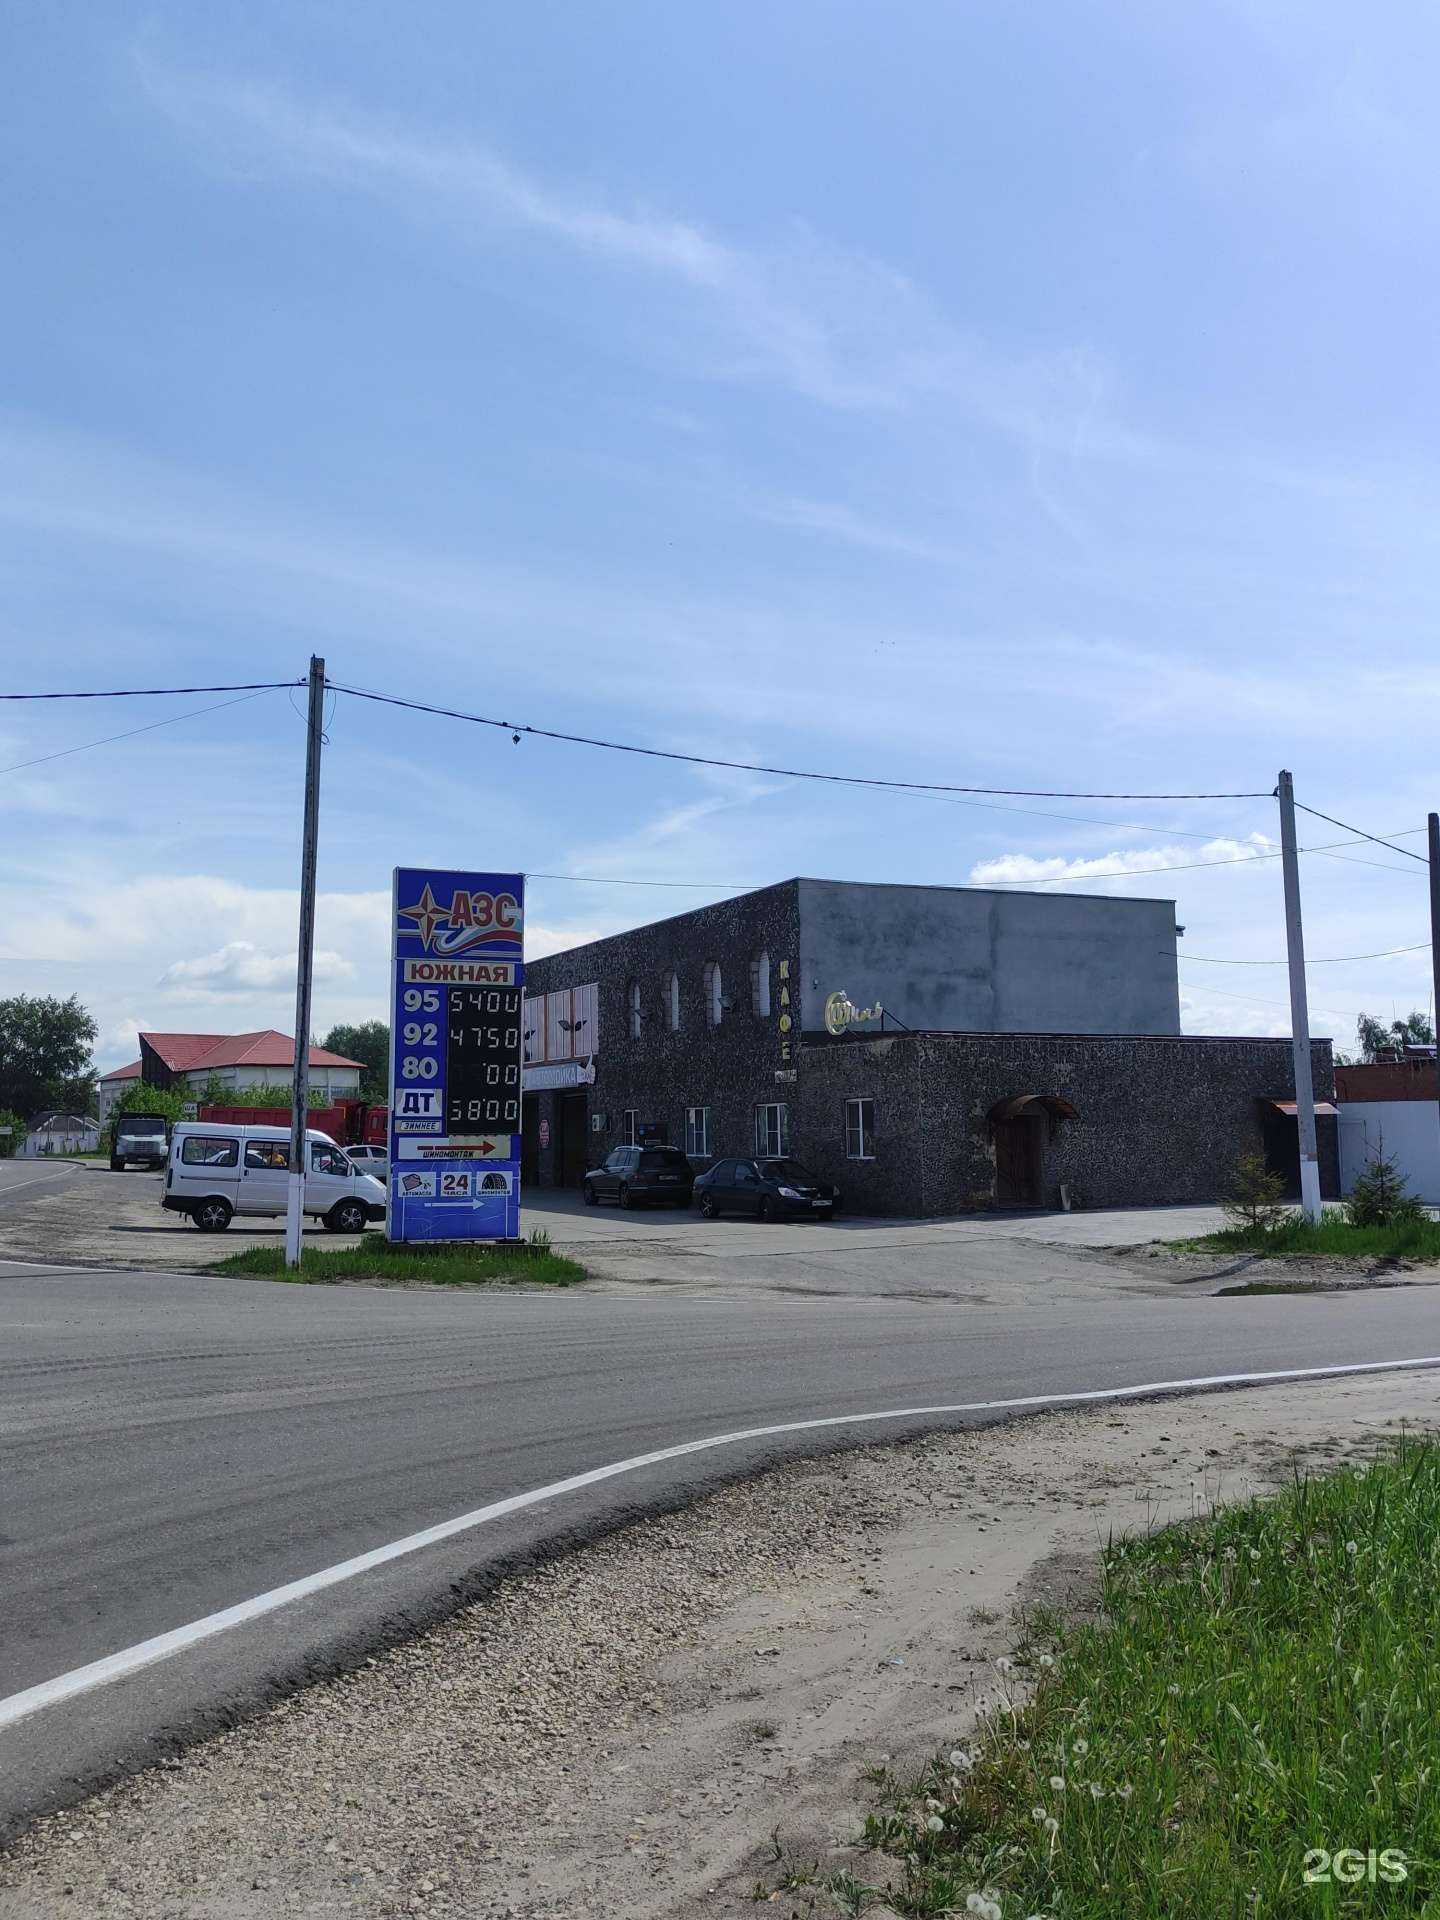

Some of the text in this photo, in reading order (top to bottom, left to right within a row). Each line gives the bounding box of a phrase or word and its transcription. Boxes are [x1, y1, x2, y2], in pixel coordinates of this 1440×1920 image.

[449, 891, 517, 928] АЗС
[411, 963, 508, 983] ЮЖНАЯ
[403, 989, 440, 1013] 95
[403, 1022, 438, 1046] 92
[402, 1056, 438, 1080] 80
[529, 1067, 577, 1086] ВТОМОЙКА
[403, 1092, 435, 1114] ДТ
[422, 1150, 475, 1159] ШИНОМОНТАЖ
[443, 1174, 469, 1191] 24
